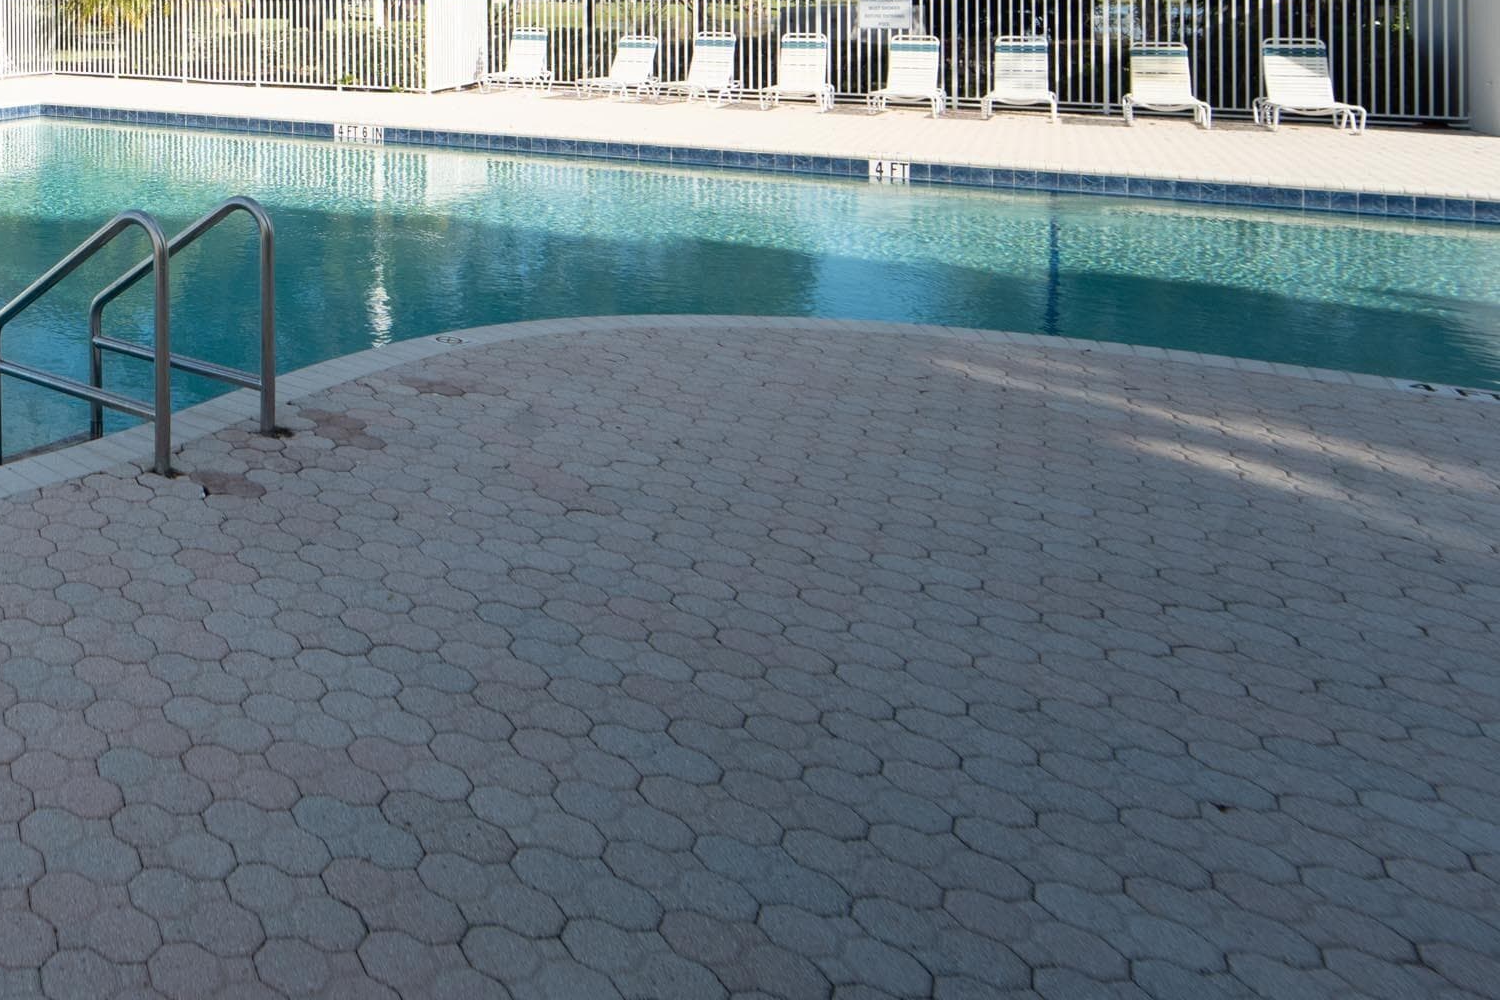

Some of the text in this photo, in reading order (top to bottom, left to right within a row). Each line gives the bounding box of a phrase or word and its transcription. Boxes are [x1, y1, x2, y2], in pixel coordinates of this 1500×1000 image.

[338, 125, 383, 139] 4 FT 6 IN
[875, 161, 908, 179] 4 FT
